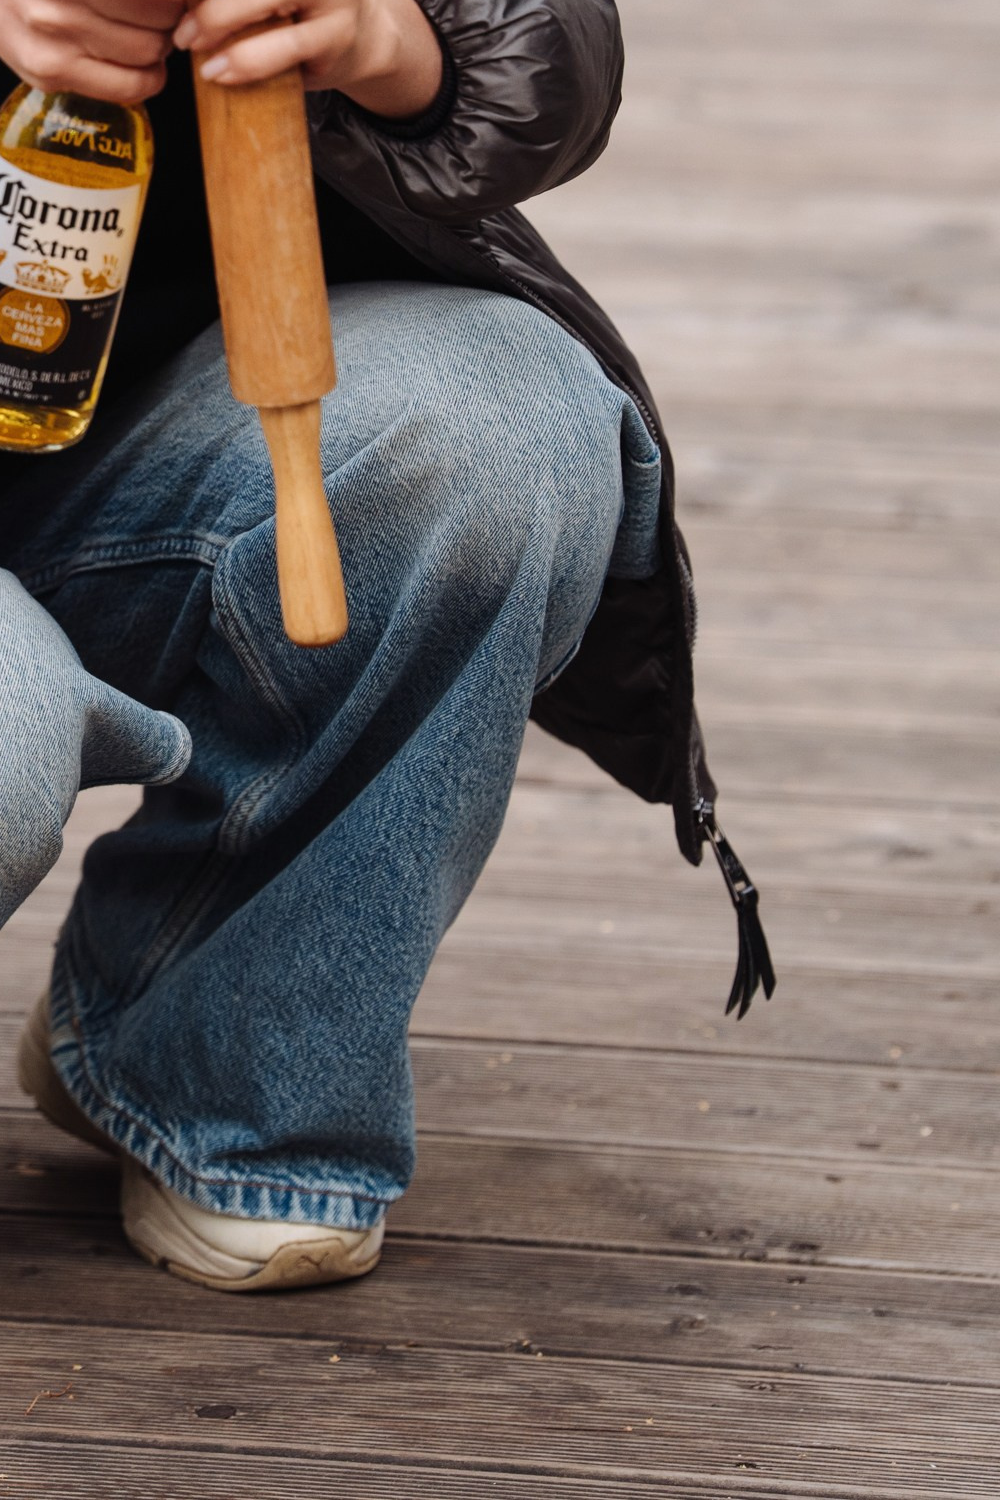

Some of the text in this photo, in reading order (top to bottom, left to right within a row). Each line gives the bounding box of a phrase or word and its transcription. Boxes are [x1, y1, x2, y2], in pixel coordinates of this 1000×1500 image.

[13, 222, 88, 262] Extra
[24, 301, 44, 314] LA
[1, 305, 63, 328] CERVEZA
[14, 321, 46, 337] MAS
[11, 331, 43, 348] FINA
